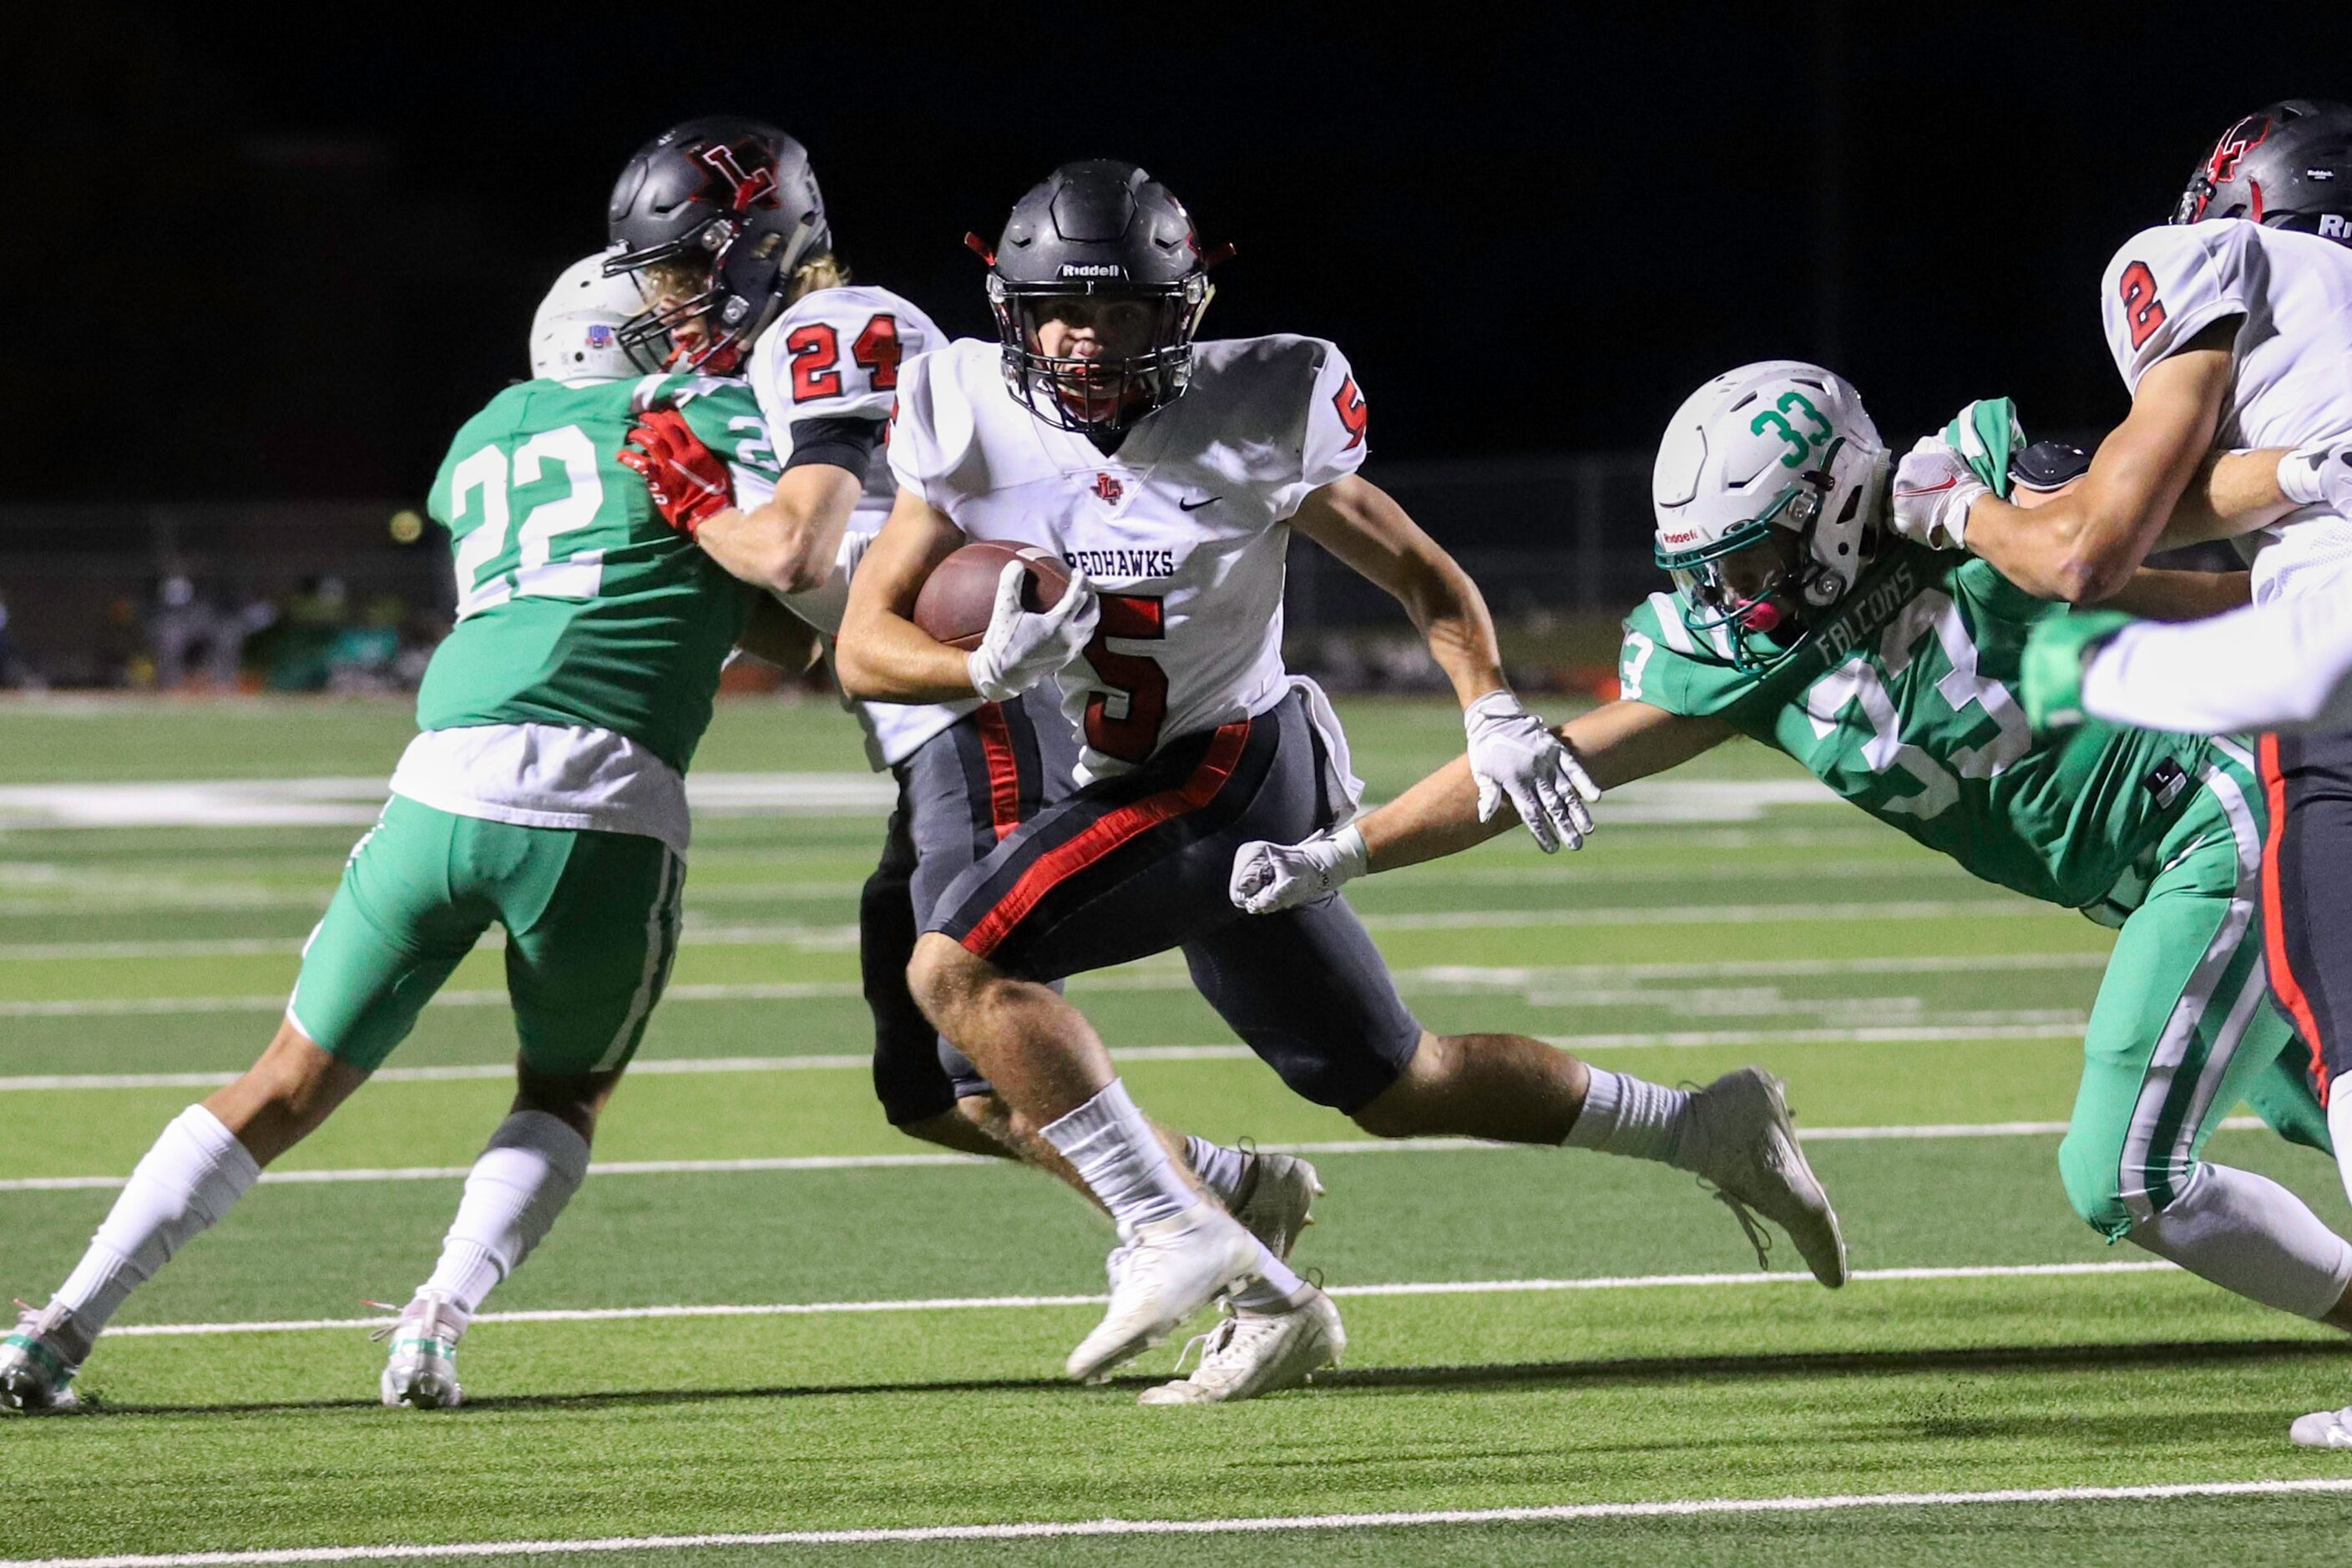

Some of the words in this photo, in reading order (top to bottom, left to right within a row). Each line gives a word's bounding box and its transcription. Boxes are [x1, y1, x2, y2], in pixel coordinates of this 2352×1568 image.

[702, 144, 777, 210] L
[1063, 265, 1119, 276] Riddell
[2120, 260, 2167, 352] 2
[786, 313, 903, 405] 24
[1332, 372, 1368, 453] 5
[1751, 392, 1833, 468] 33
[452, 424, 608, 625] 22
[1063, 550, 1174, 577] REDHAWKS
[1814, 561, 1914, 666] FALCONS
[1083, 592, 1169, 765] 5
[1807, 587, 2032, 821] 33
